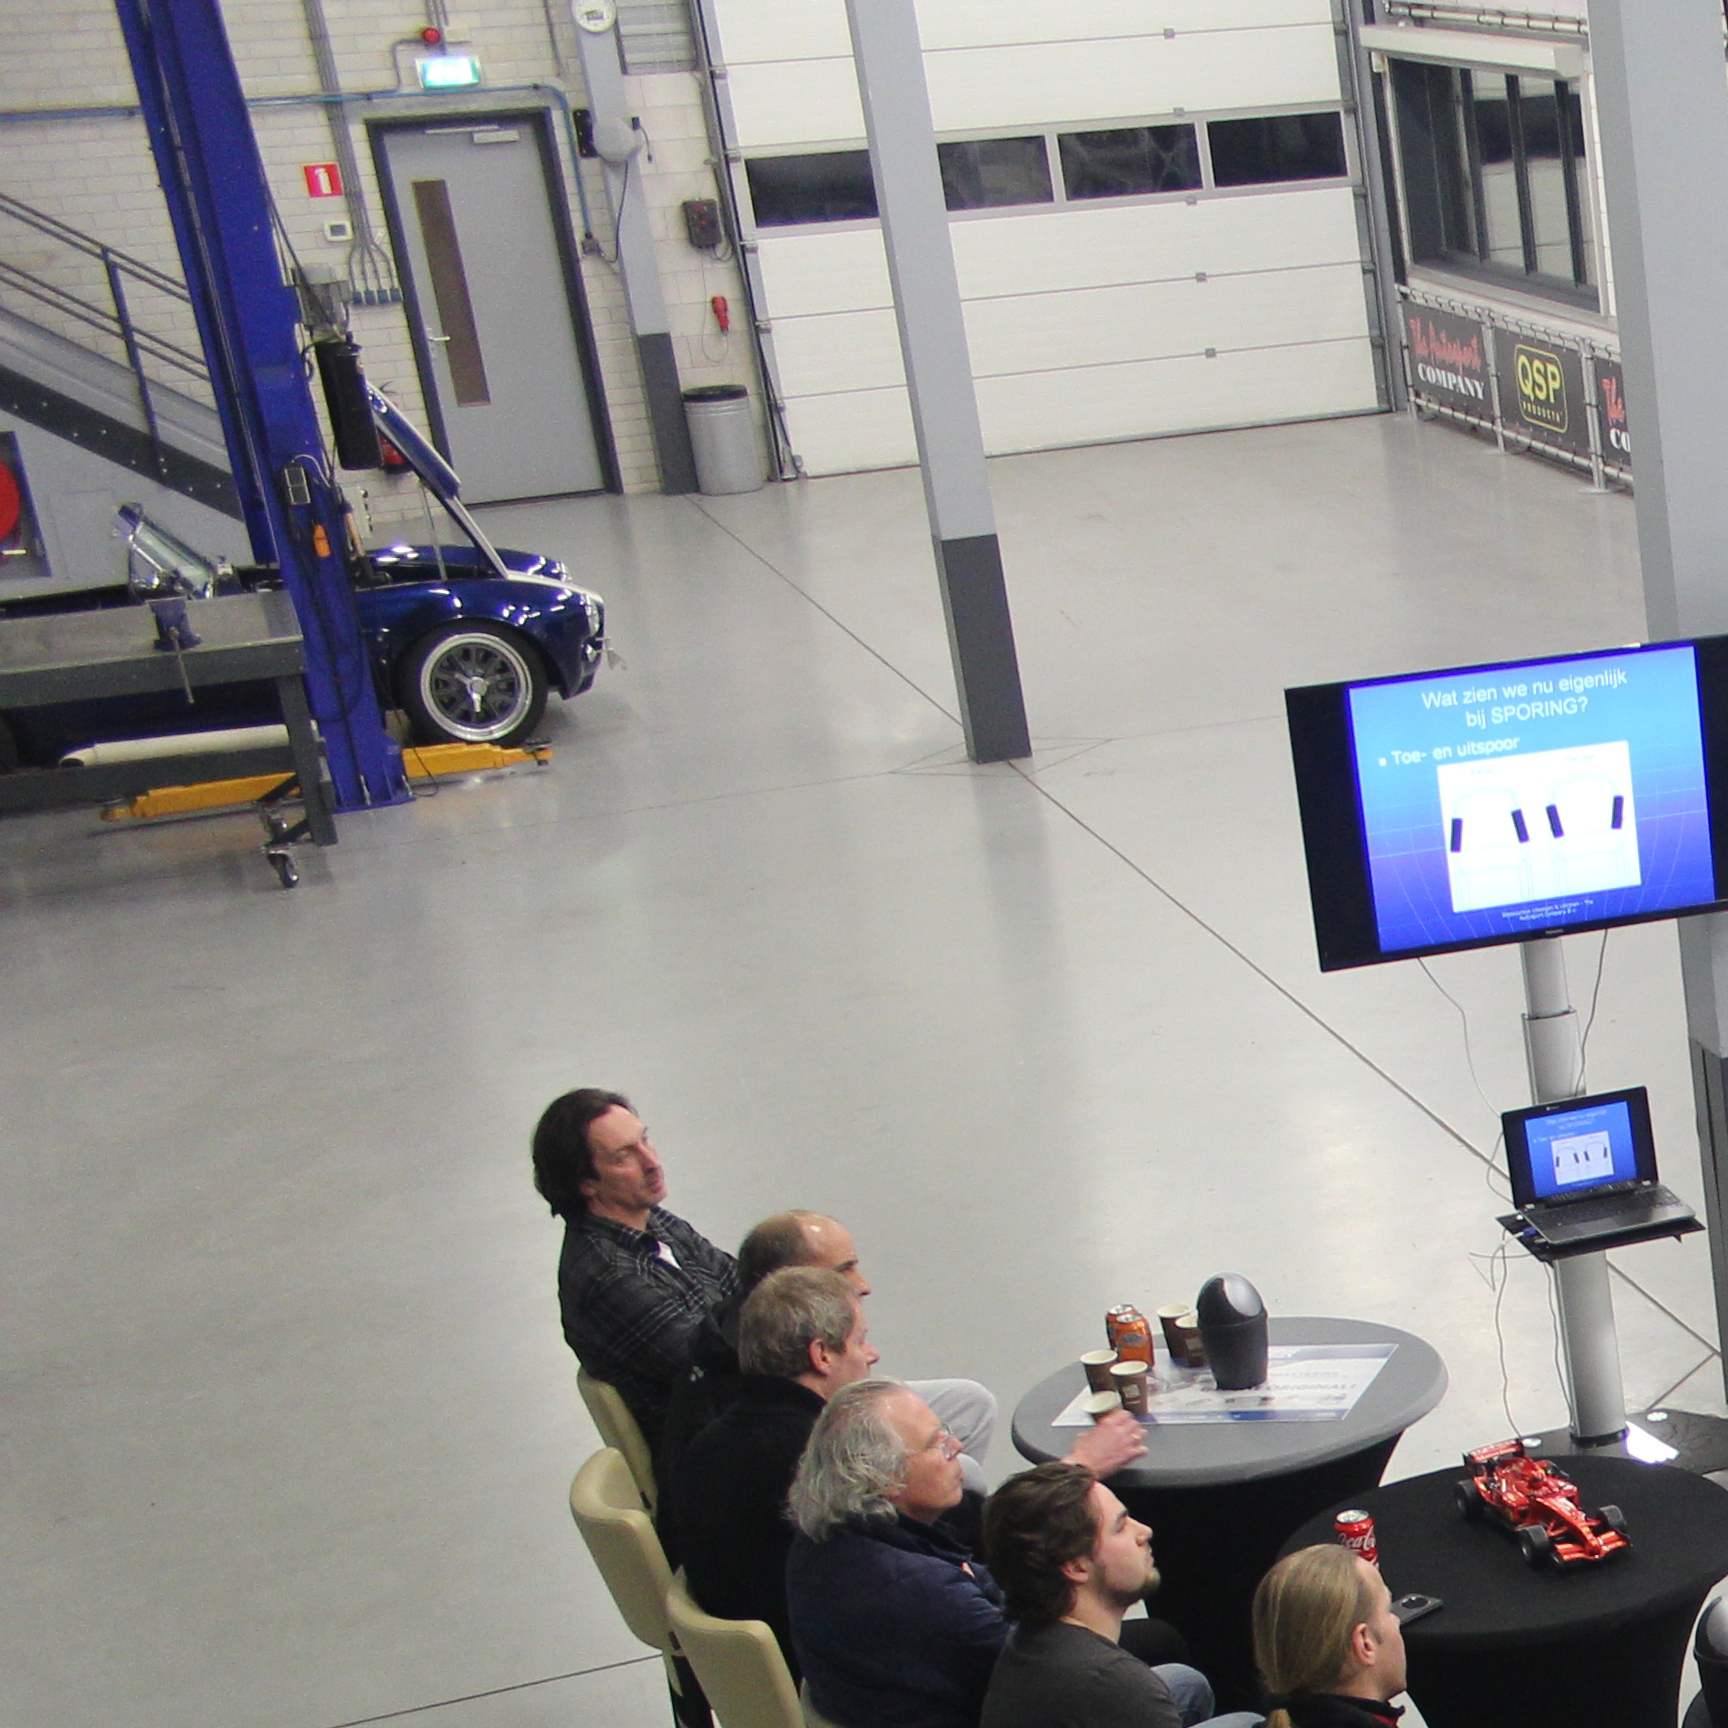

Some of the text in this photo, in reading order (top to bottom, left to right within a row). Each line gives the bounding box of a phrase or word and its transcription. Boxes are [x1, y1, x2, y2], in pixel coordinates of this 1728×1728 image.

[1417, 362, 1485, 401] COMPANY
[1517, 354, 1562, 404] QSP
[1421, 668, 1628, 709] Wat zien we nu eigenlijk
[1465, 696, 1589, 729] bij SPORING?
[1391, 737, 1521, 766] Toe- en uitspoor
